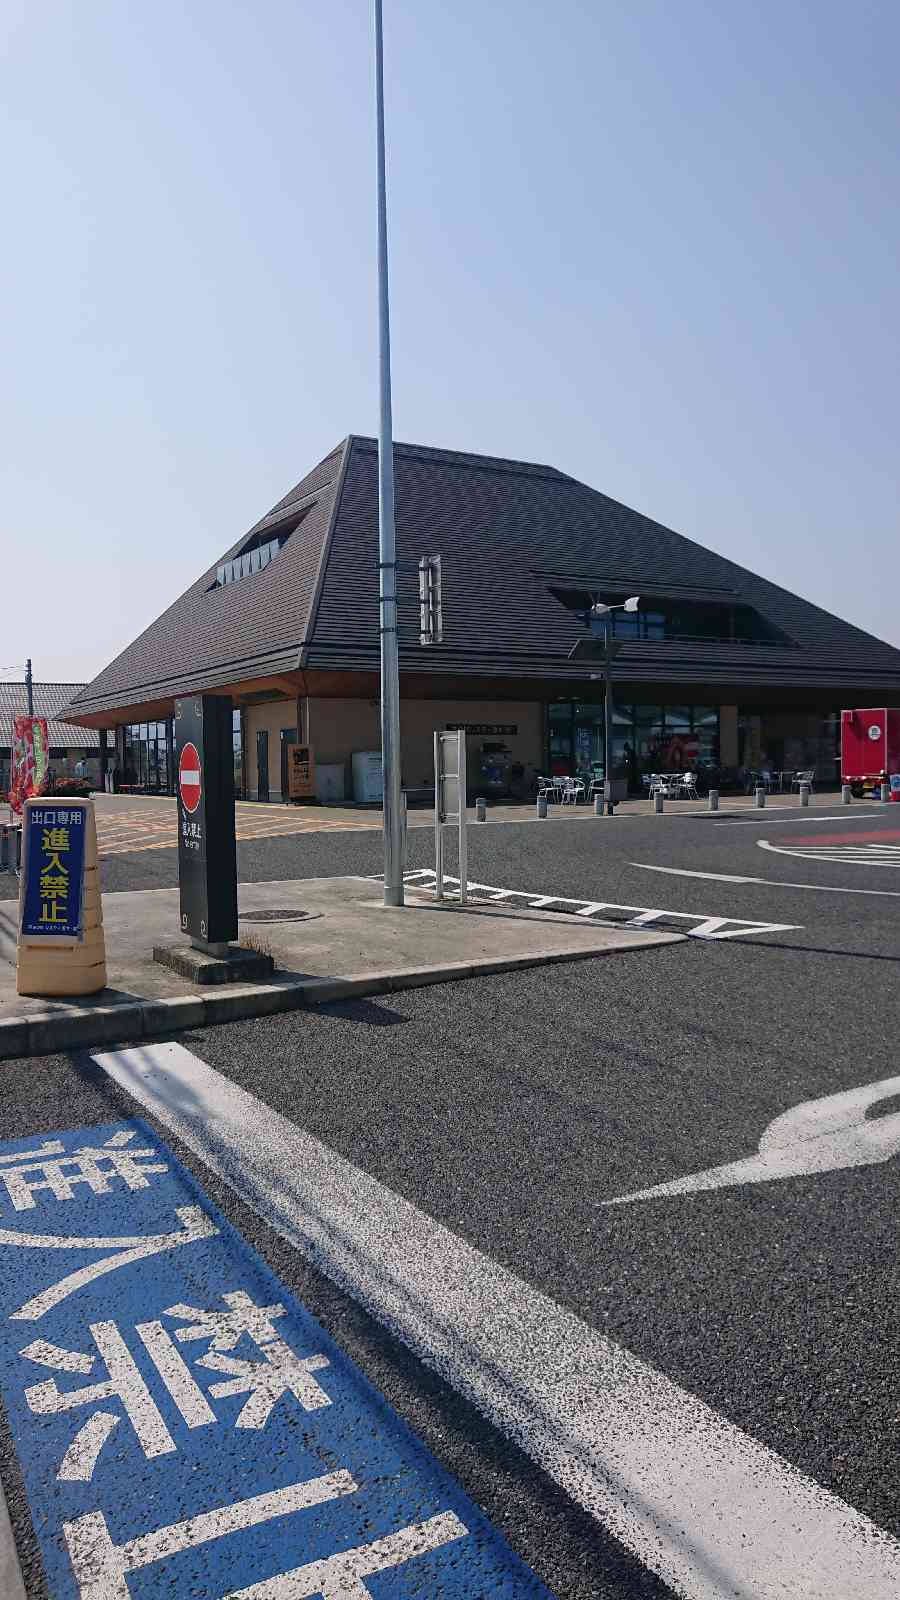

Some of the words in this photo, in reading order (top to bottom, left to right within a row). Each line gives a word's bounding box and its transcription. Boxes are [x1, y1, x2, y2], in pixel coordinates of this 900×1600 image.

[31, 811, 82, 825] 出口専用
[39, 828, 70, 923] 進入禁止
